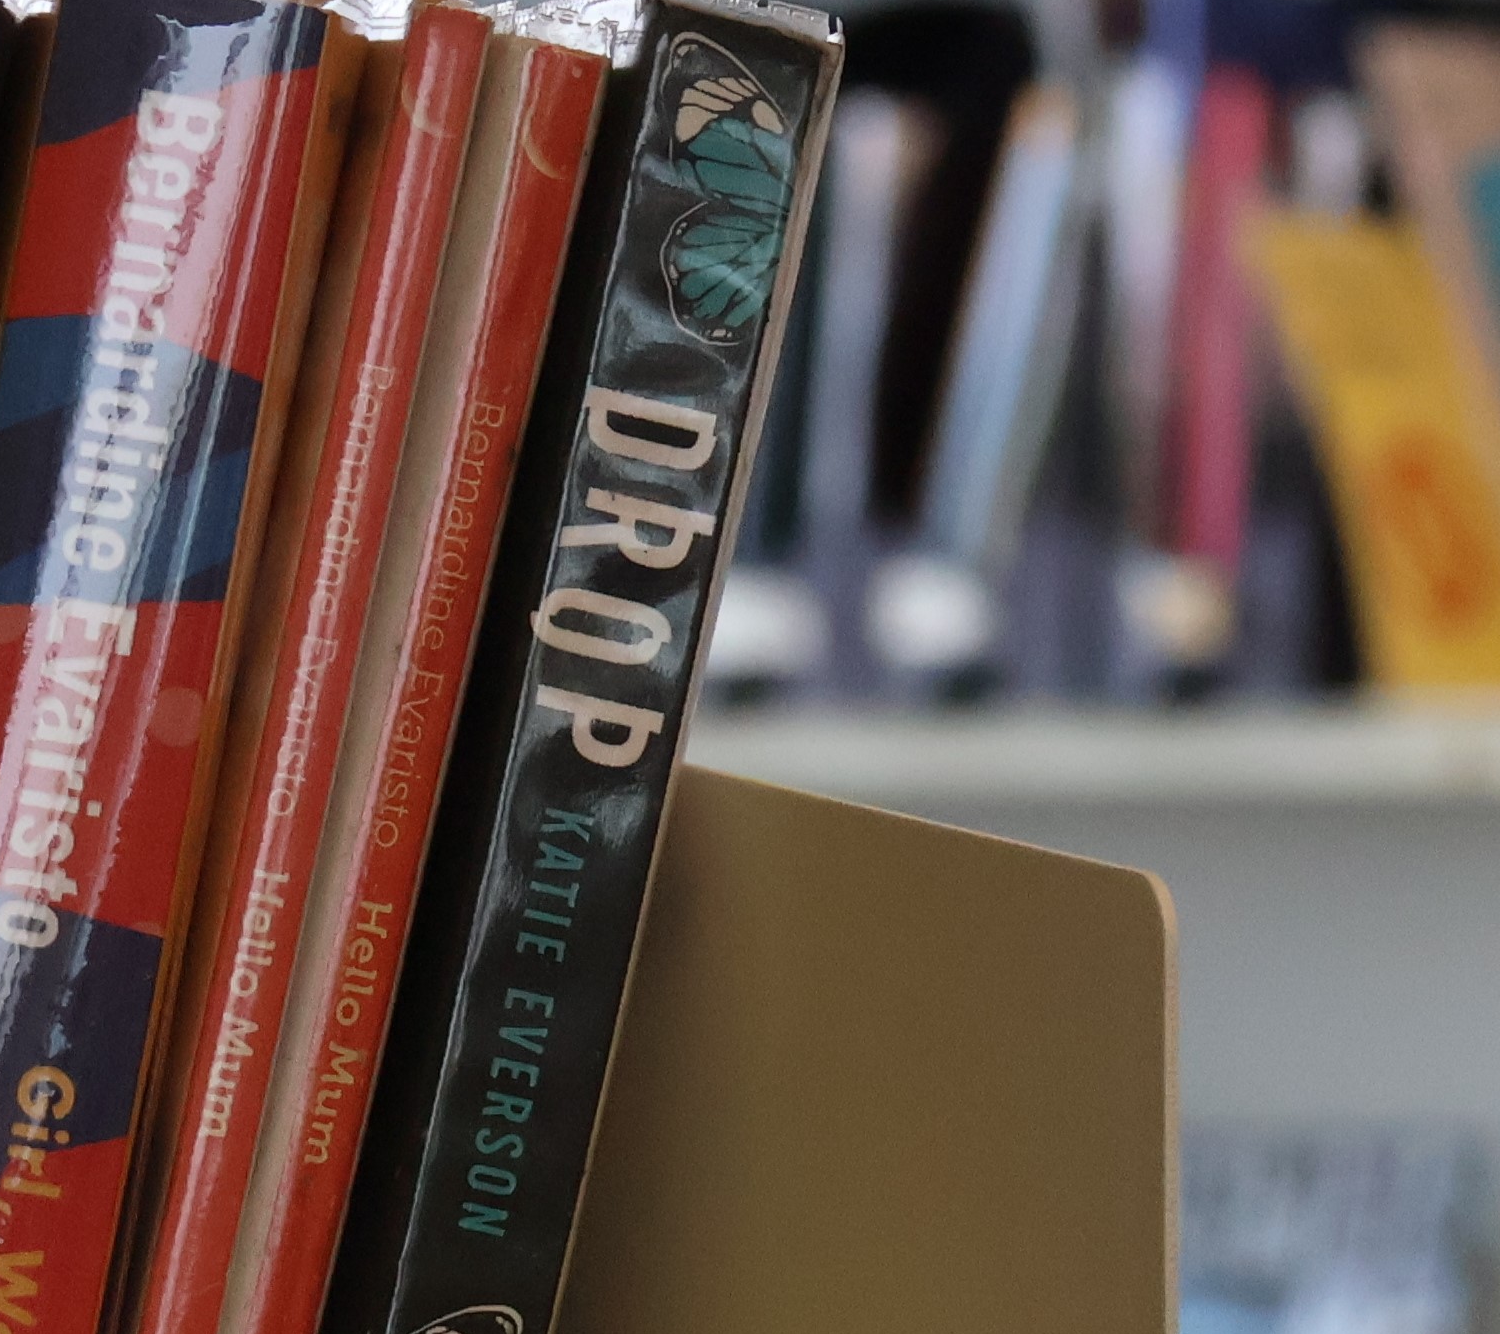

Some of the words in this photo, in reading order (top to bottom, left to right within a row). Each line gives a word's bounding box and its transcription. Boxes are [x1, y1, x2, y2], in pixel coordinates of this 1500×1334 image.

[62, 88, 226, 573] Bernardine
[310, 363, 394, 619] Bernardine
[419, 400, 506, 651] Bernardine
[530, 384, 717, 768] DROP
[268, 637, 338, 817] Evaristo
[372, 669, 446, 849] Evaristo
[235, 869, 289, 996] Hello
[333, 899, 392, 1027] Hello
[518, 807, 595, 964] KATIE
[197, 1017, 258, 1139] Mum
[304, 1041, 364, 1165] Mum
[458, 983, 555, 1238] EVERSON
